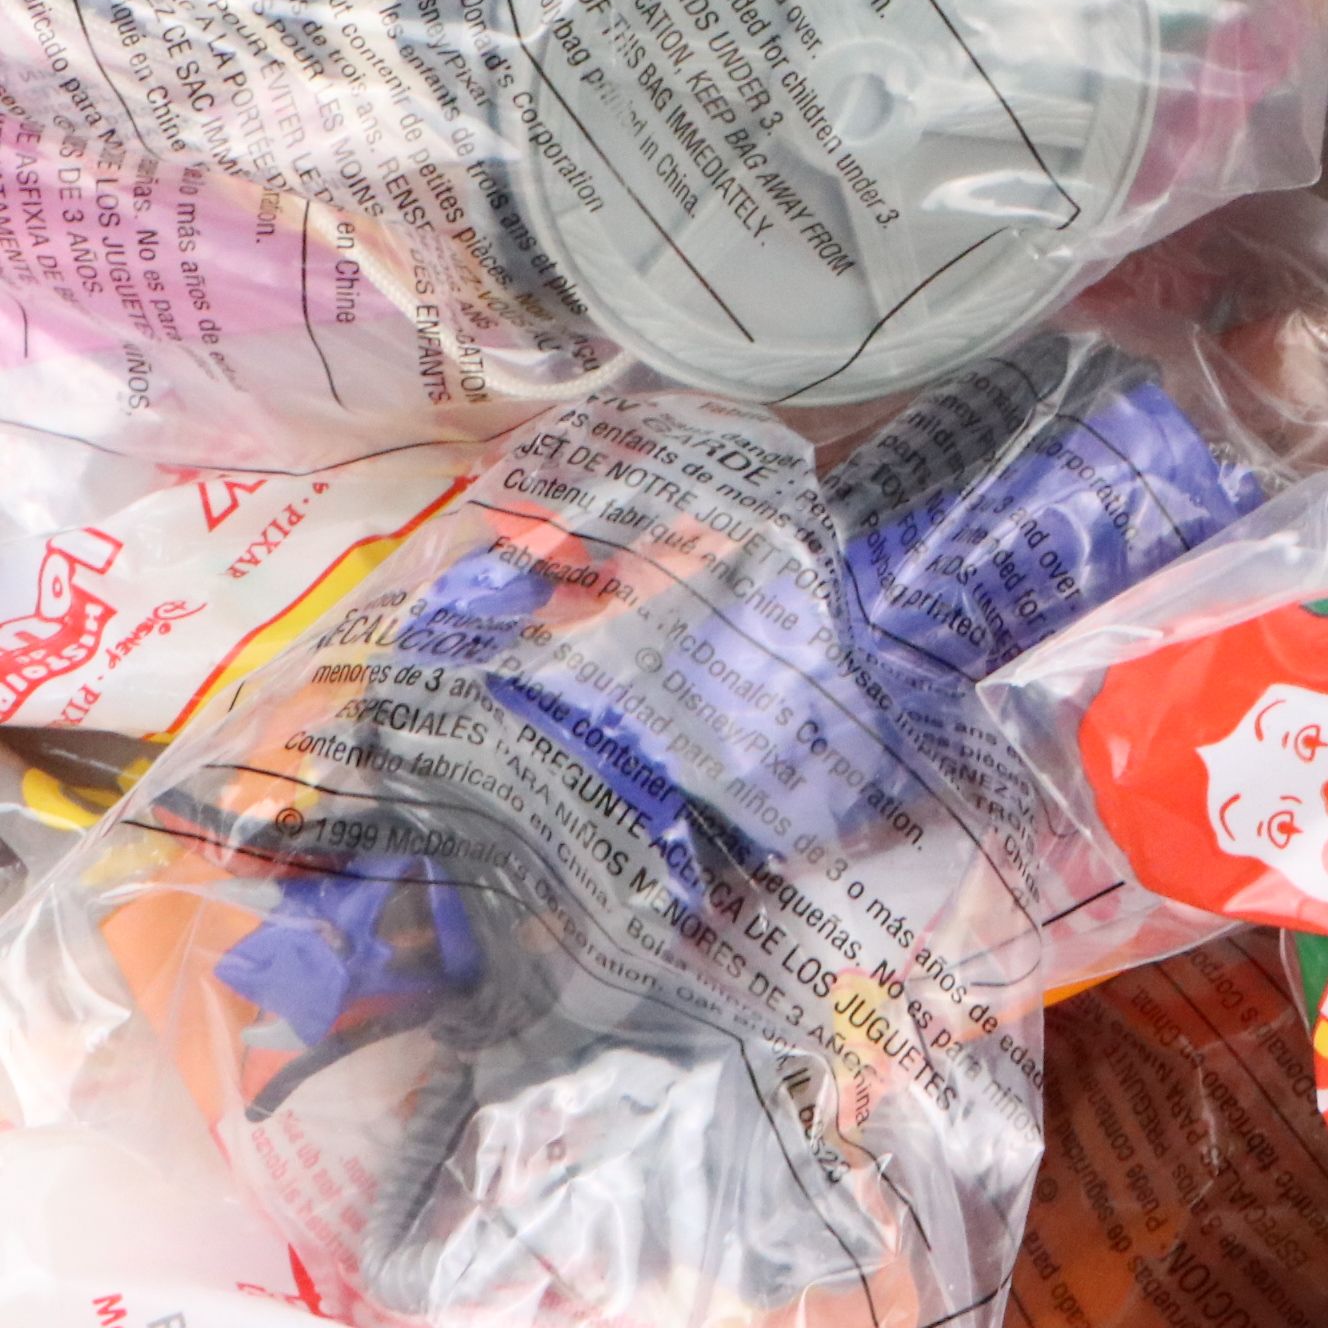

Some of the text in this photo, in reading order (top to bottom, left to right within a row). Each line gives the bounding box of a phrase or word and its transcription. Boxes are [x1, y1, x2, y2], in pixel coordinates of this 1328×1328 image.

[162, 25, 216, 112] CE SAC
[708, 31, 772, 114] UNDER
[786, 5, 826, 59] over.
[146, 84, 187, 152] Chine
[399, 44, 460, 122] enfants
[399, 112, 423, 144] de
[759, 33, 790, 70] for
[781, 70, 842, 155] children
[837, 153, 888, 216] under
[14, 151, 50, 248] ASFIXIA
[57, 166, 82, 201] DE
[407, 146, 466, 225] petites
[512, 88, 605, 215] Corporation
[638, 63, 674, 112] BAG
[665, 103, 776, 248] IMMEDIATELY.
[656, 150, 700, 219] China.
[686, 69, 737, 128] KEEP
[725, 127, 769, 172] BAG
[756, 170, 810, 224] AWAY
[799, 221, 857, 277] FROM
[136, 230, 161, 262] No
[176, 200, 201, 253] más
[333, 221, 360, 324] en Chine
[416, 304, 452, 405] ENFANTS
[598, 421, 791, 528] enfants moins
[604, 462, 786, 564] NOTRE JOUET
[227, 504, 304, 580] PIXAR
[1039, 551, 1083, 611] over.
[731, 578, 801, 631] Chine
[487, 536, 599, 588] Fabricado
[795, 719, 926, 852] Corporation.
[661, 673, 810, 794] Disney/Pixar
[284, 729, 612, 915] Contenido fabricado China.
[336, 698, 631, 876] ESPECIALES NIÑOS
[552, 642, 969, 1006] seguridad niños más años
[312, 662, 388, 684] menores
[516, 723, 652, 840] PREGUNTE
[781, 945, 839, 999] LOS
[834, 993, 957, 1112] JUGUETES
[314, 817, 528, 882] 1999 McDonald's
[572, 719, 906, 1001] contener No
